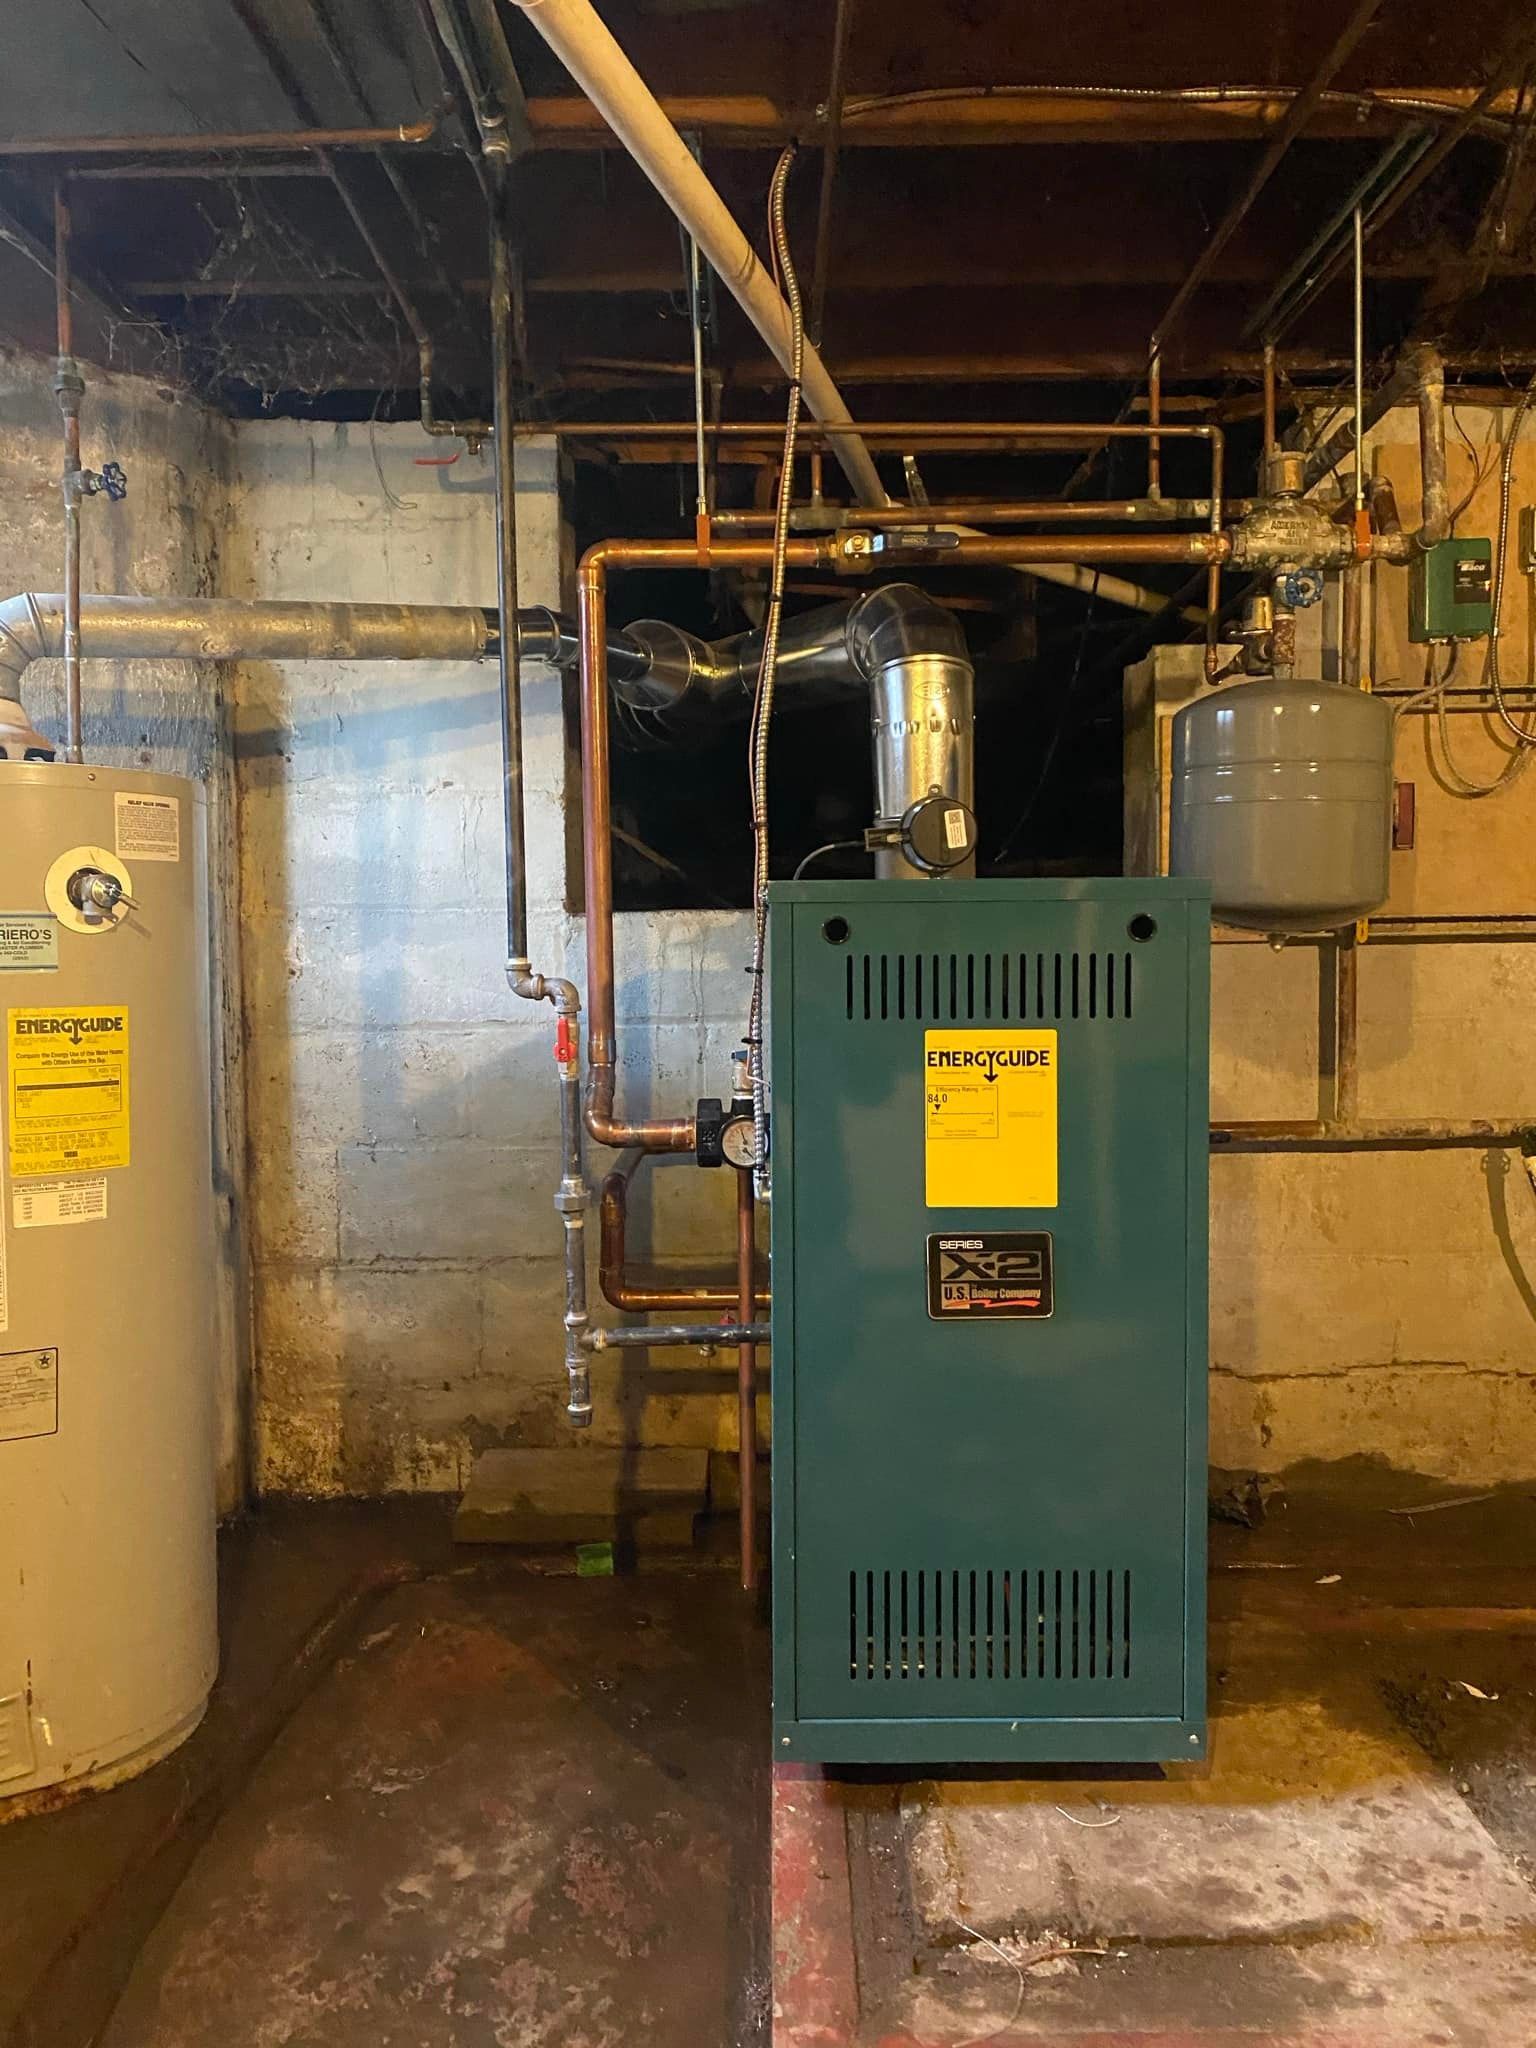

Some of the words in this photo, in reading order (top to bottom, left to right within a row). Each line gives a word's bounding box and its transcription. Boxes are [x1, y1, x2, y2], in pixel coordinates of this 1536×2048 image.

[16, 1017, 122, 1037] ENERGYGUIDE
[928, 1050, 1050, 1071] ENERGYGUIDE
[928, 1093, 948, 1103] 84.0
[939, 1240, 983, 1249] SERIES
[944, 1286, 969, 1300] U.S.
[972, 1288, 998, 1298] Boiler
[999, 1288, 1041, 1299] Company
